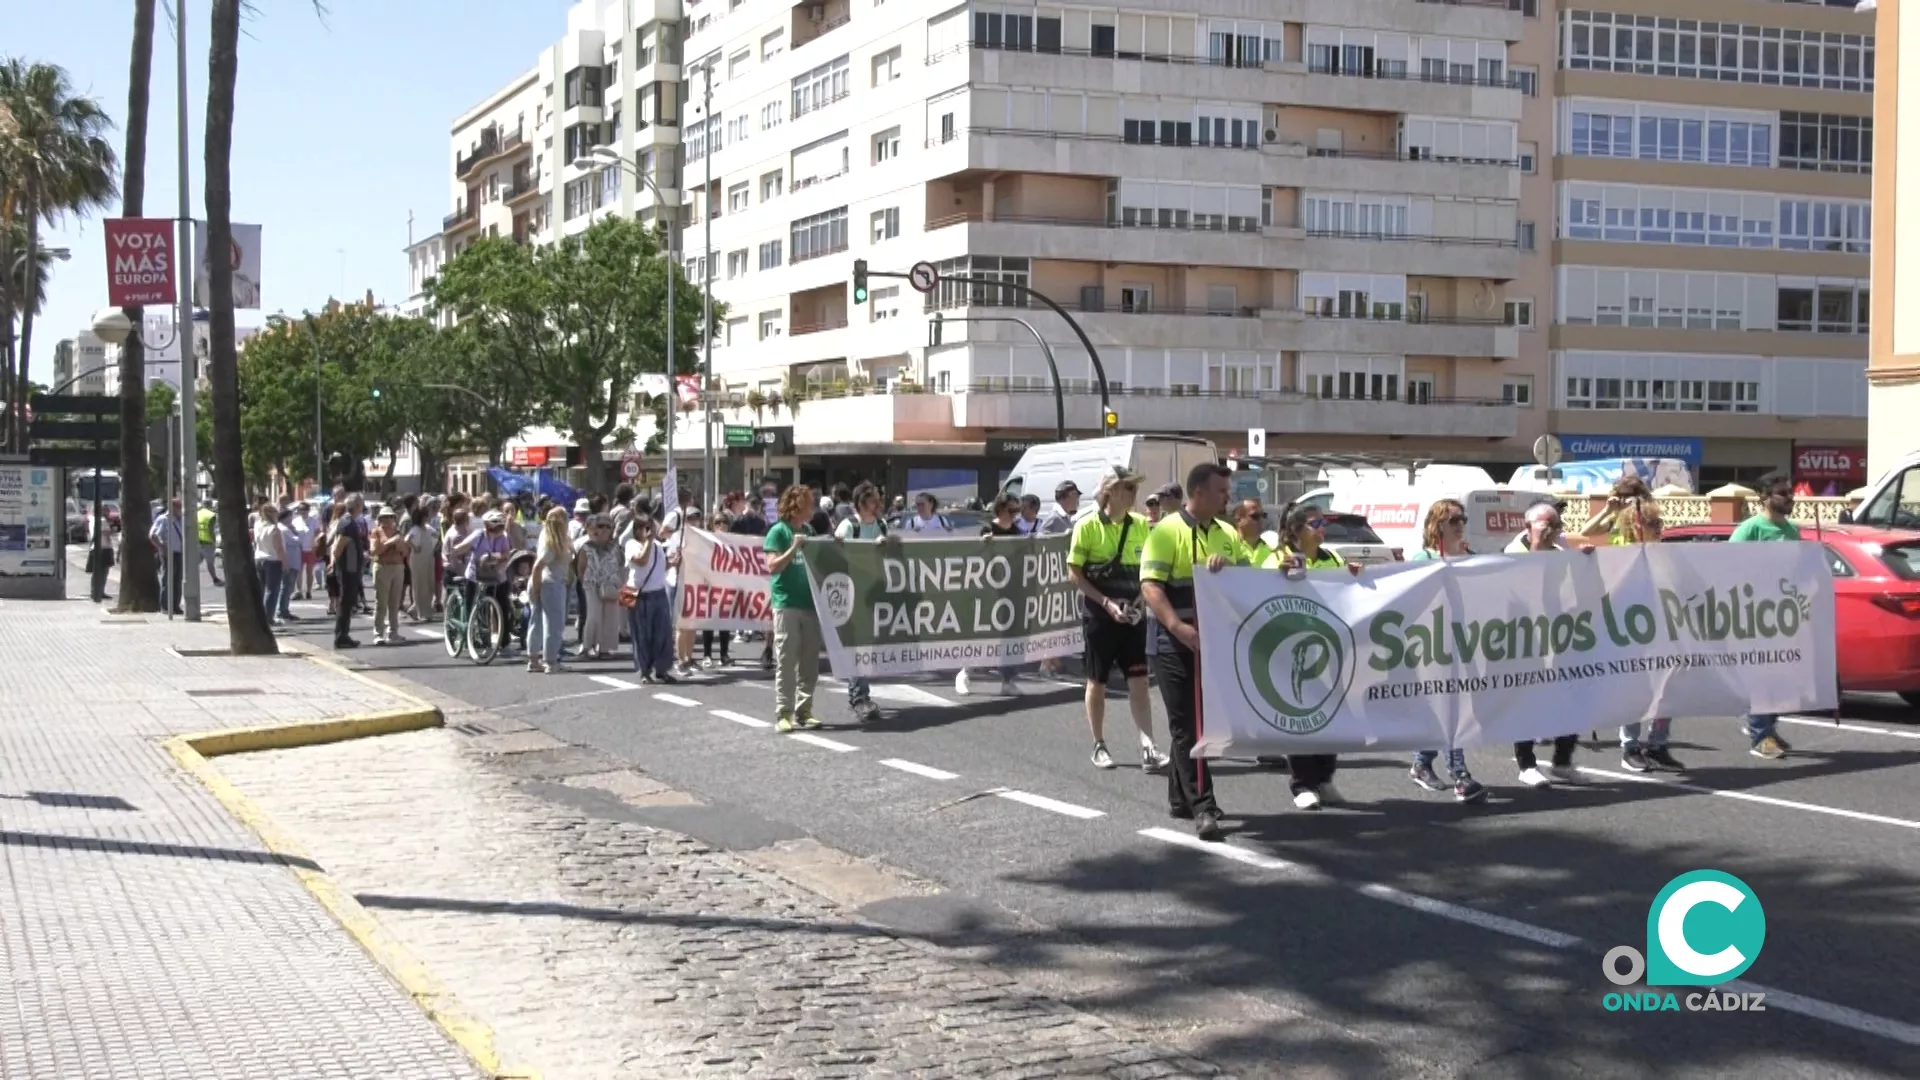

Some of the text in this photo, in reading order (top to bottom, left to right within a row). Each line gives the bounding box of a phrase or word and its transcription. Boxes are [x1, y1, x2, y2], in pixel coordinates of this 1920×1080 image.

[113, 233, 167, 249] VOTA
[115, 248, 168, 273] MÁS
[115, 273, 169, 285] EUROPA
[1570, 438, 1692, 456] CLÍNICA VETERINARIA
[1368, 500, 1416, 525] jamón
[1489, 511, 1502, 527] el
[883, 556, 1012, 593] DINERO
[873, 600, 961, 637] PARA
[974, 598, 1015, 632] LO
[1264, 600, 1319, 617] SALVEMOS
[1368, 583, 1800, 671] Salvemos lo Público
[855, 652, 877, 666] POR
[882, 652, 897, 663] LA
[901, 644, 982, 662] ELIMINACIÓN
[986, 645, 1001, 657] DE
[1006, 643, 1024, 656] LOS
[1368, 676, 1489, 700] RECUPEREMOS
[1491, 675, 1501, 689] Y
[1503, 661, 1605, 688] DEFENDAMOS
[1609, 654, 1682, 675] NUESTROS
[1741, 648, 1802, 664] PÚBLICOS
[1274, 712, 1287, 727] LO
